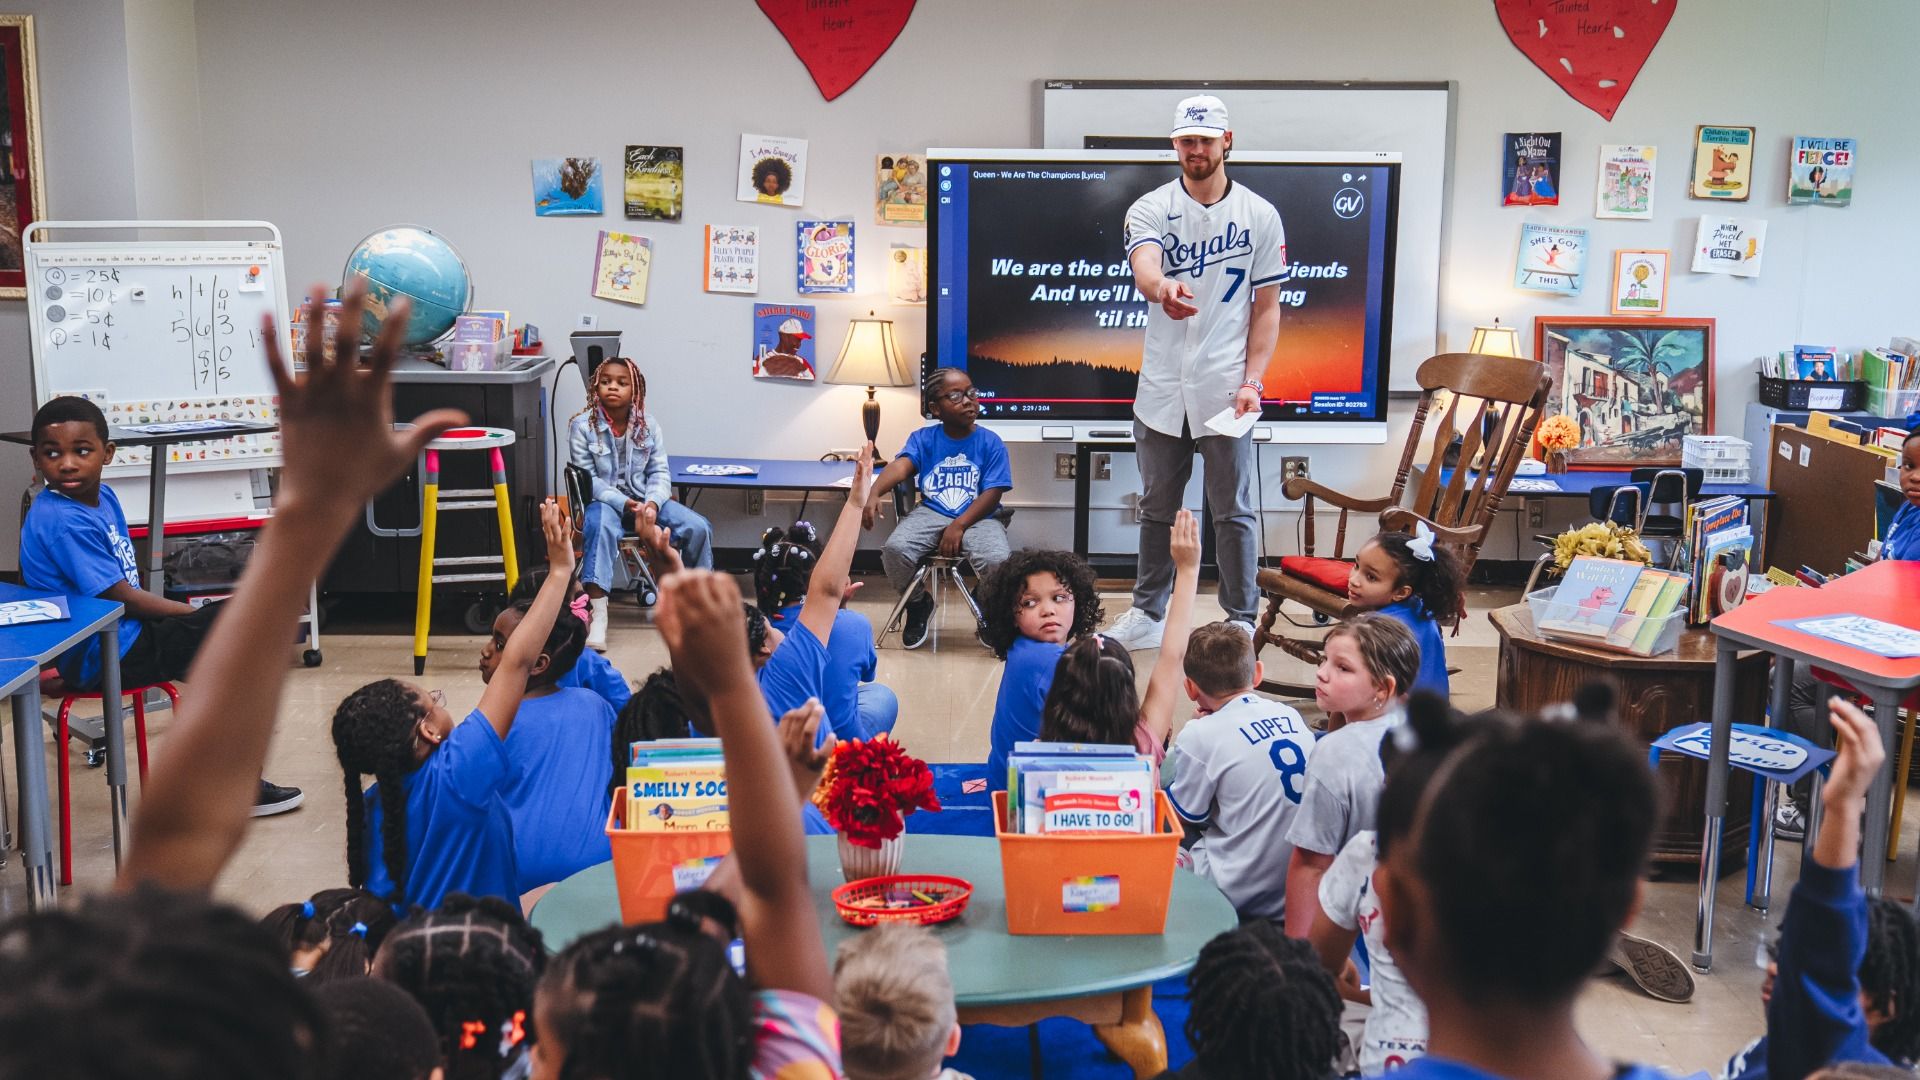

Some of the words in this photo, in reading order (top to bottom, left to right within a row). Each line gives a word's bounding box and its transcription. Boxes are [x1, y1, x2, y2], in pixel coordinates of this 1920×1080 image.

[822, 16, 855, 32] Heart
[1578, 19, 1611, 36] Heart
[1514, 140, 1520, 150] A
[1800, 140, 1805, 149] I
[1807, 140, 1829, 150] WILL
[1835, 141, 1849, 150] BE
[1798, 150, 1850, 166] FIERCE!
[973, 171, 996, 180] Queen
[1001, 171, 1012, 179] We
[1013, 171, 1026, 179] Are
[1027, 171, 1040, 179] The
[1041, 171, 1080, 181] Champions
[1712, 229, 1744, 241] Pencil
[1161, 221, 1252, 279] Royals
[1719, 240, 1732, 248] MET
[991, 259, 1024, 276] We
[1028, 263, 1064, 276] are
[1068, 259, 1103, 276] the
[1107, 260, 1133, 276] ch
[1288, 262, 1348, 278] riends
[1221, 267, 1246, 303] 7
[1539, 276, 1559, 285] THIS
[1031, 284, 1076, 301] And
[1079, 285, 1131, 301] we'll
[1094, 310, 1123, 327] 'til
[1126, 310, 1149, 327] th
[171, 318, 191, 342] 5
[195, 316, 211, 337] 6
[217, 314, 234, 335] 3
[218, 366, 231, 380] 5
[929, 470, 980, 491] LEAGUE
[1239, 717, 1298, 745] LOPEZ
[1268, 738, 1307, 805] 8
[633, 782, 690, 798] SMELLY
[695, 781, 728, 797] SOC
[1053, 813, 1057, 827] I
[1060, 813, 1091, 827] HAVE
[1095, 813, 1110, 826] TO
[1114, 813, 1134, 827] GO!
[1378, 1039, 1425, 1053] TEXA
